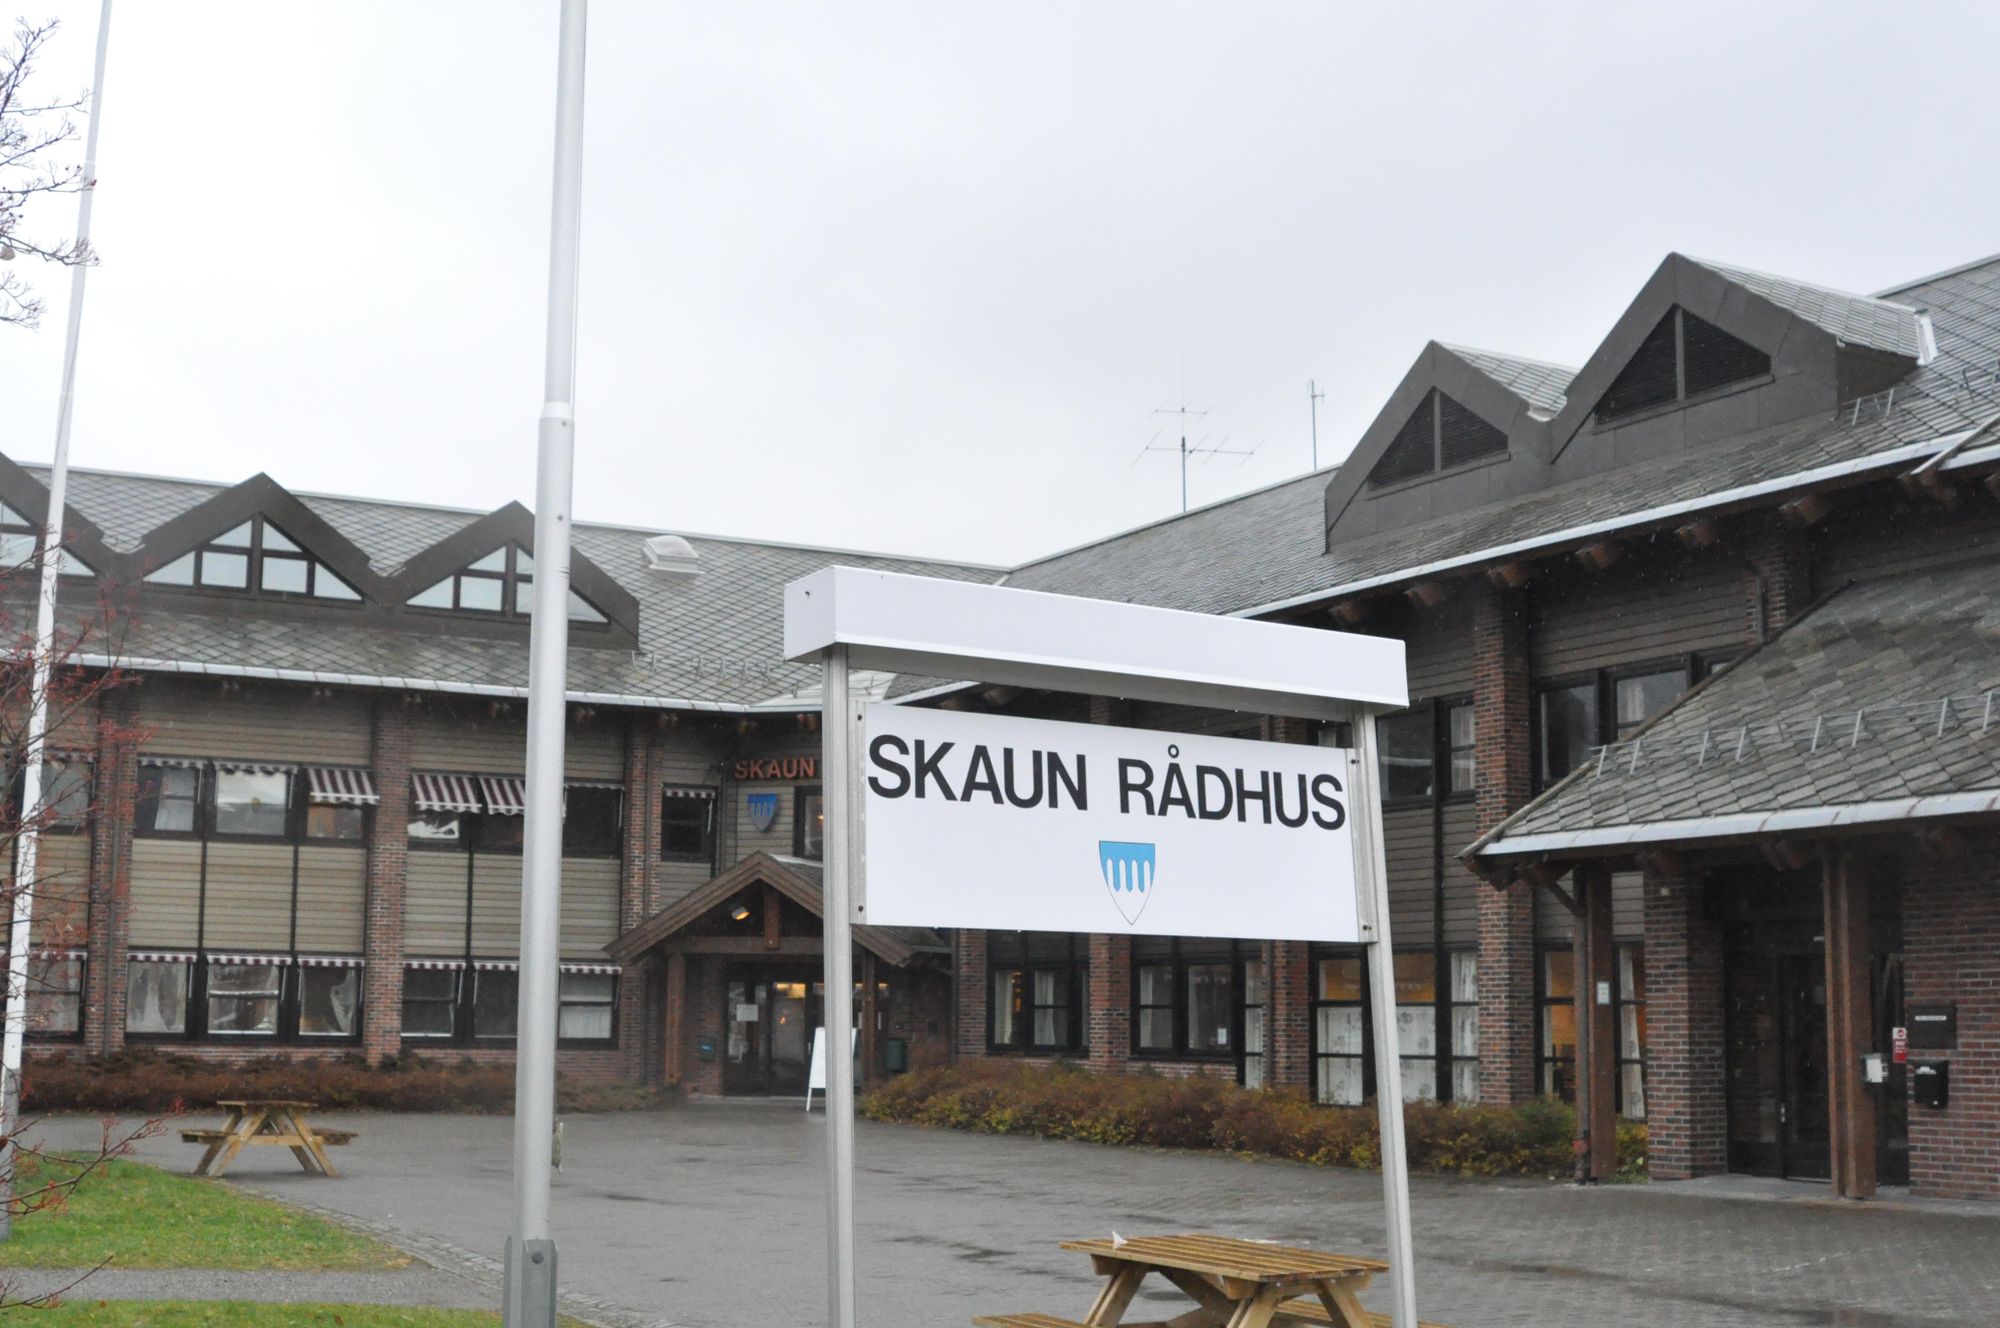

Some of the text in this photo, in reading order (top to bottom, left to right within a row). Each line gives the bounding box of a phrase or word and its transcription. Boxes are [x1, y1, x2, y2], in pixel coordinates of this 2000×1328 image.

[735, 757, 816, 779] SKAUN
[868, 734, 1346, 831] SKAUN RÅDHUS
